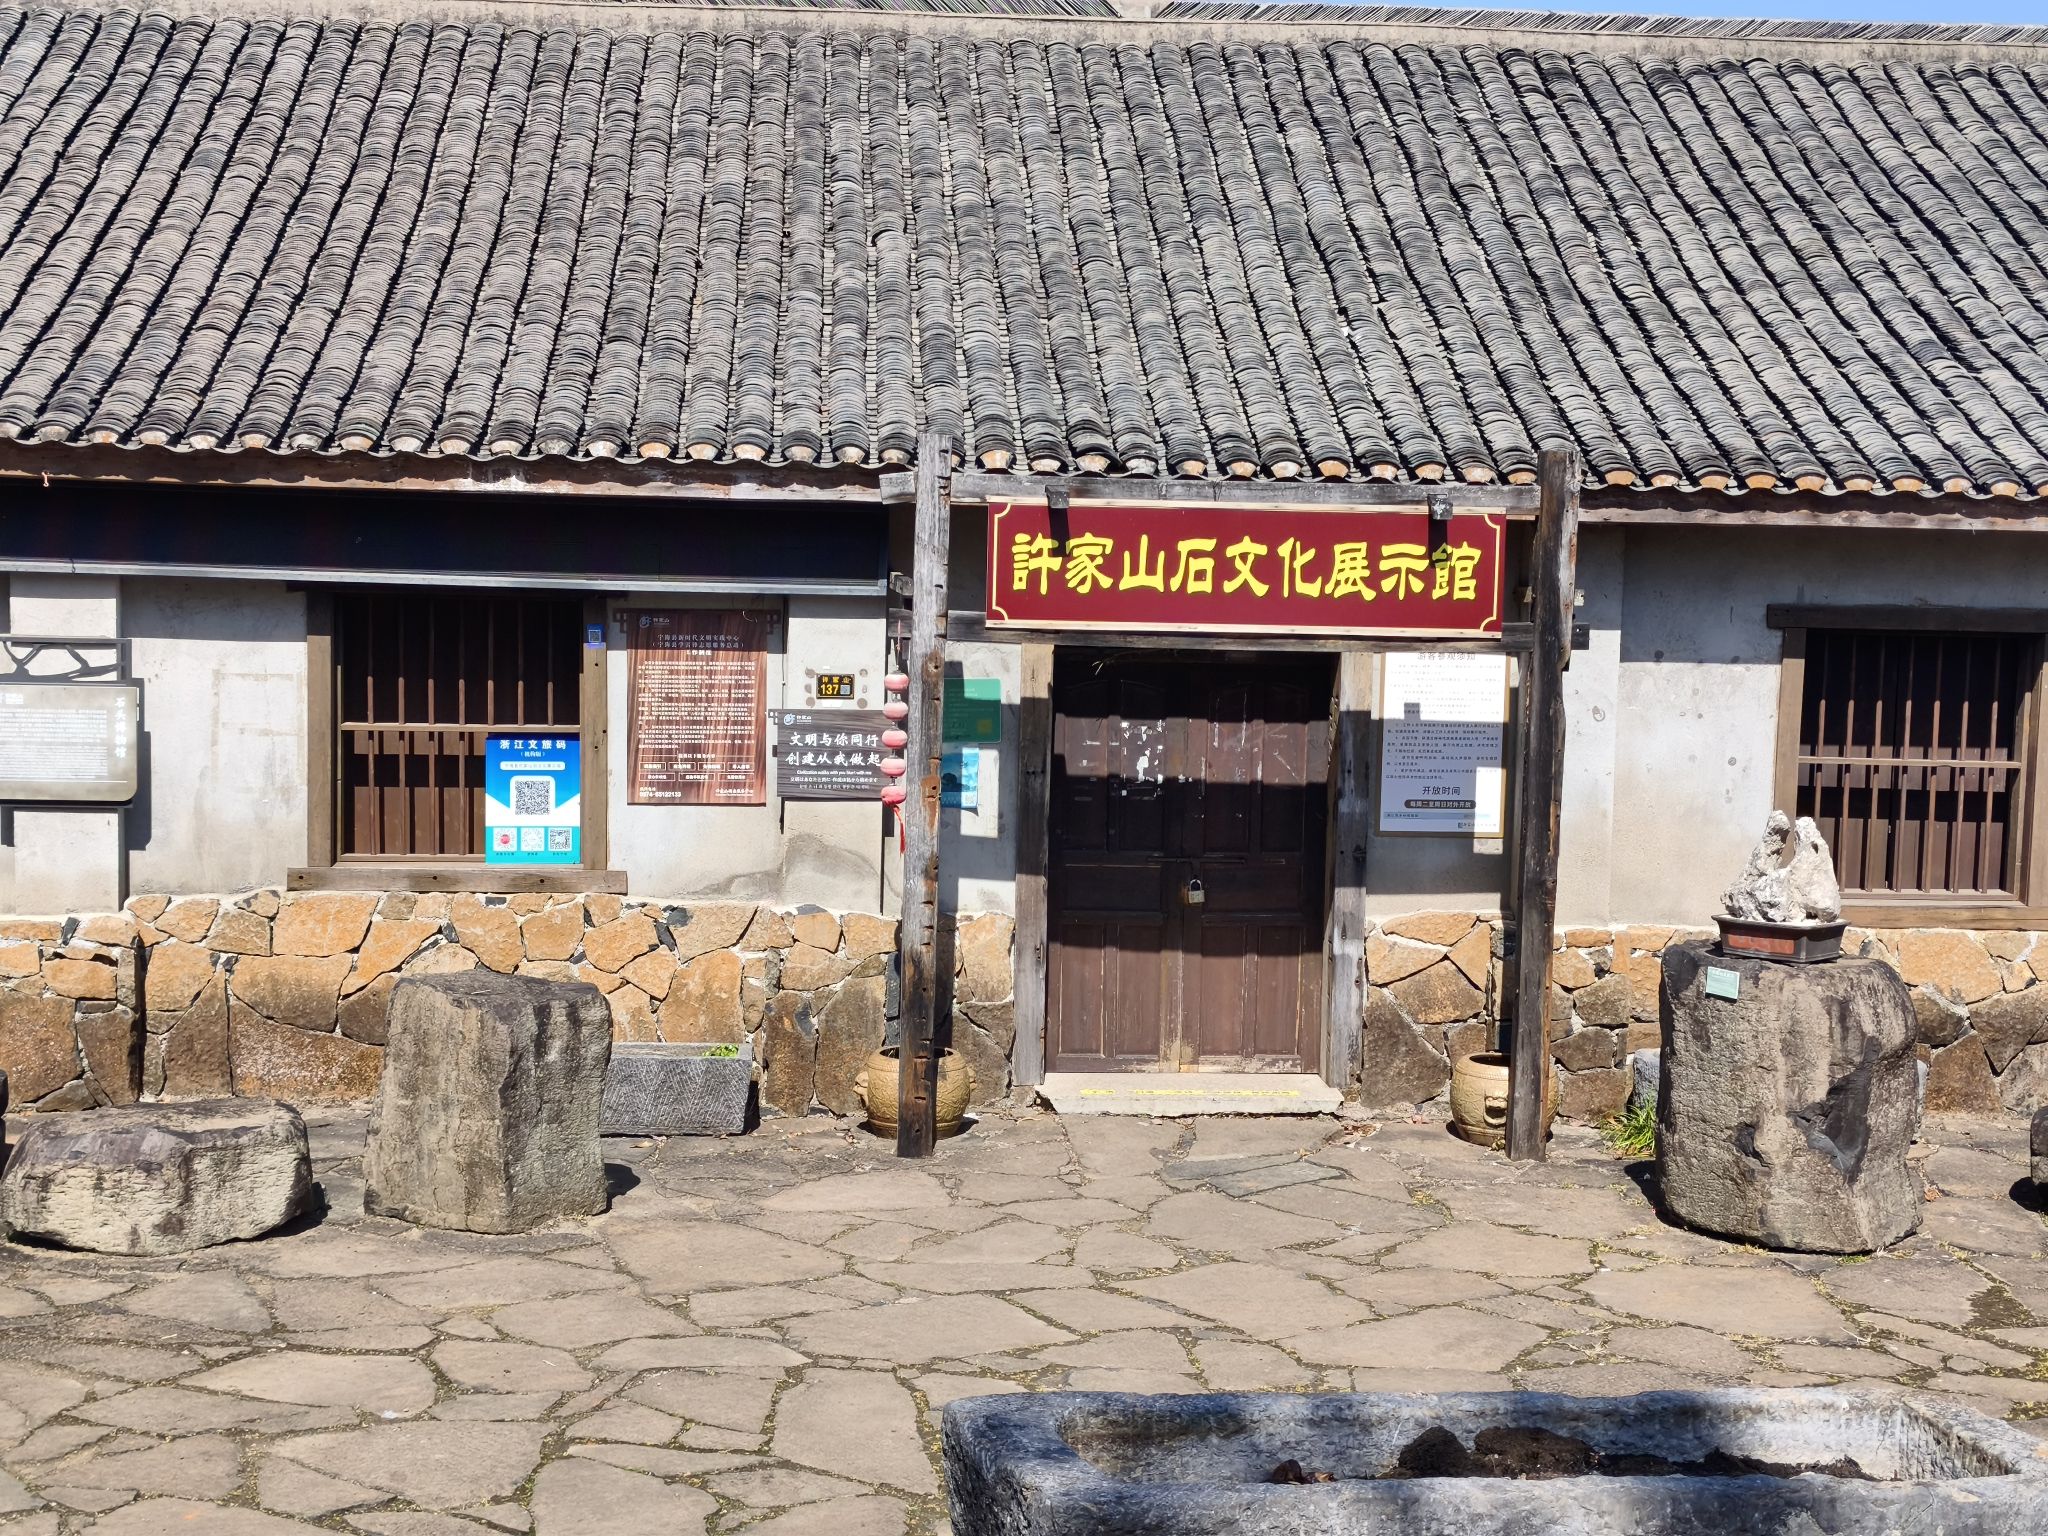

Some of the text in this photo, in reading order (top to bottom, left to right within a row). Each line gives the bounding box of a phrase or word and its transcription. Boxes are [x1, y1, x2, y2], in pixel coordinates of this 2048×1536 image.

[1011, 532, 1481, 601] 許家山石文化展示館
[821, 684, 839, 695] 137
[500, 740, 566, 750] 浙江文旅码
[789, 731, 879, 747] 文明与你同行
[785, 751, 881, 767] 创建从我做起
[1421, 786, 1461, 796] 开放时间
